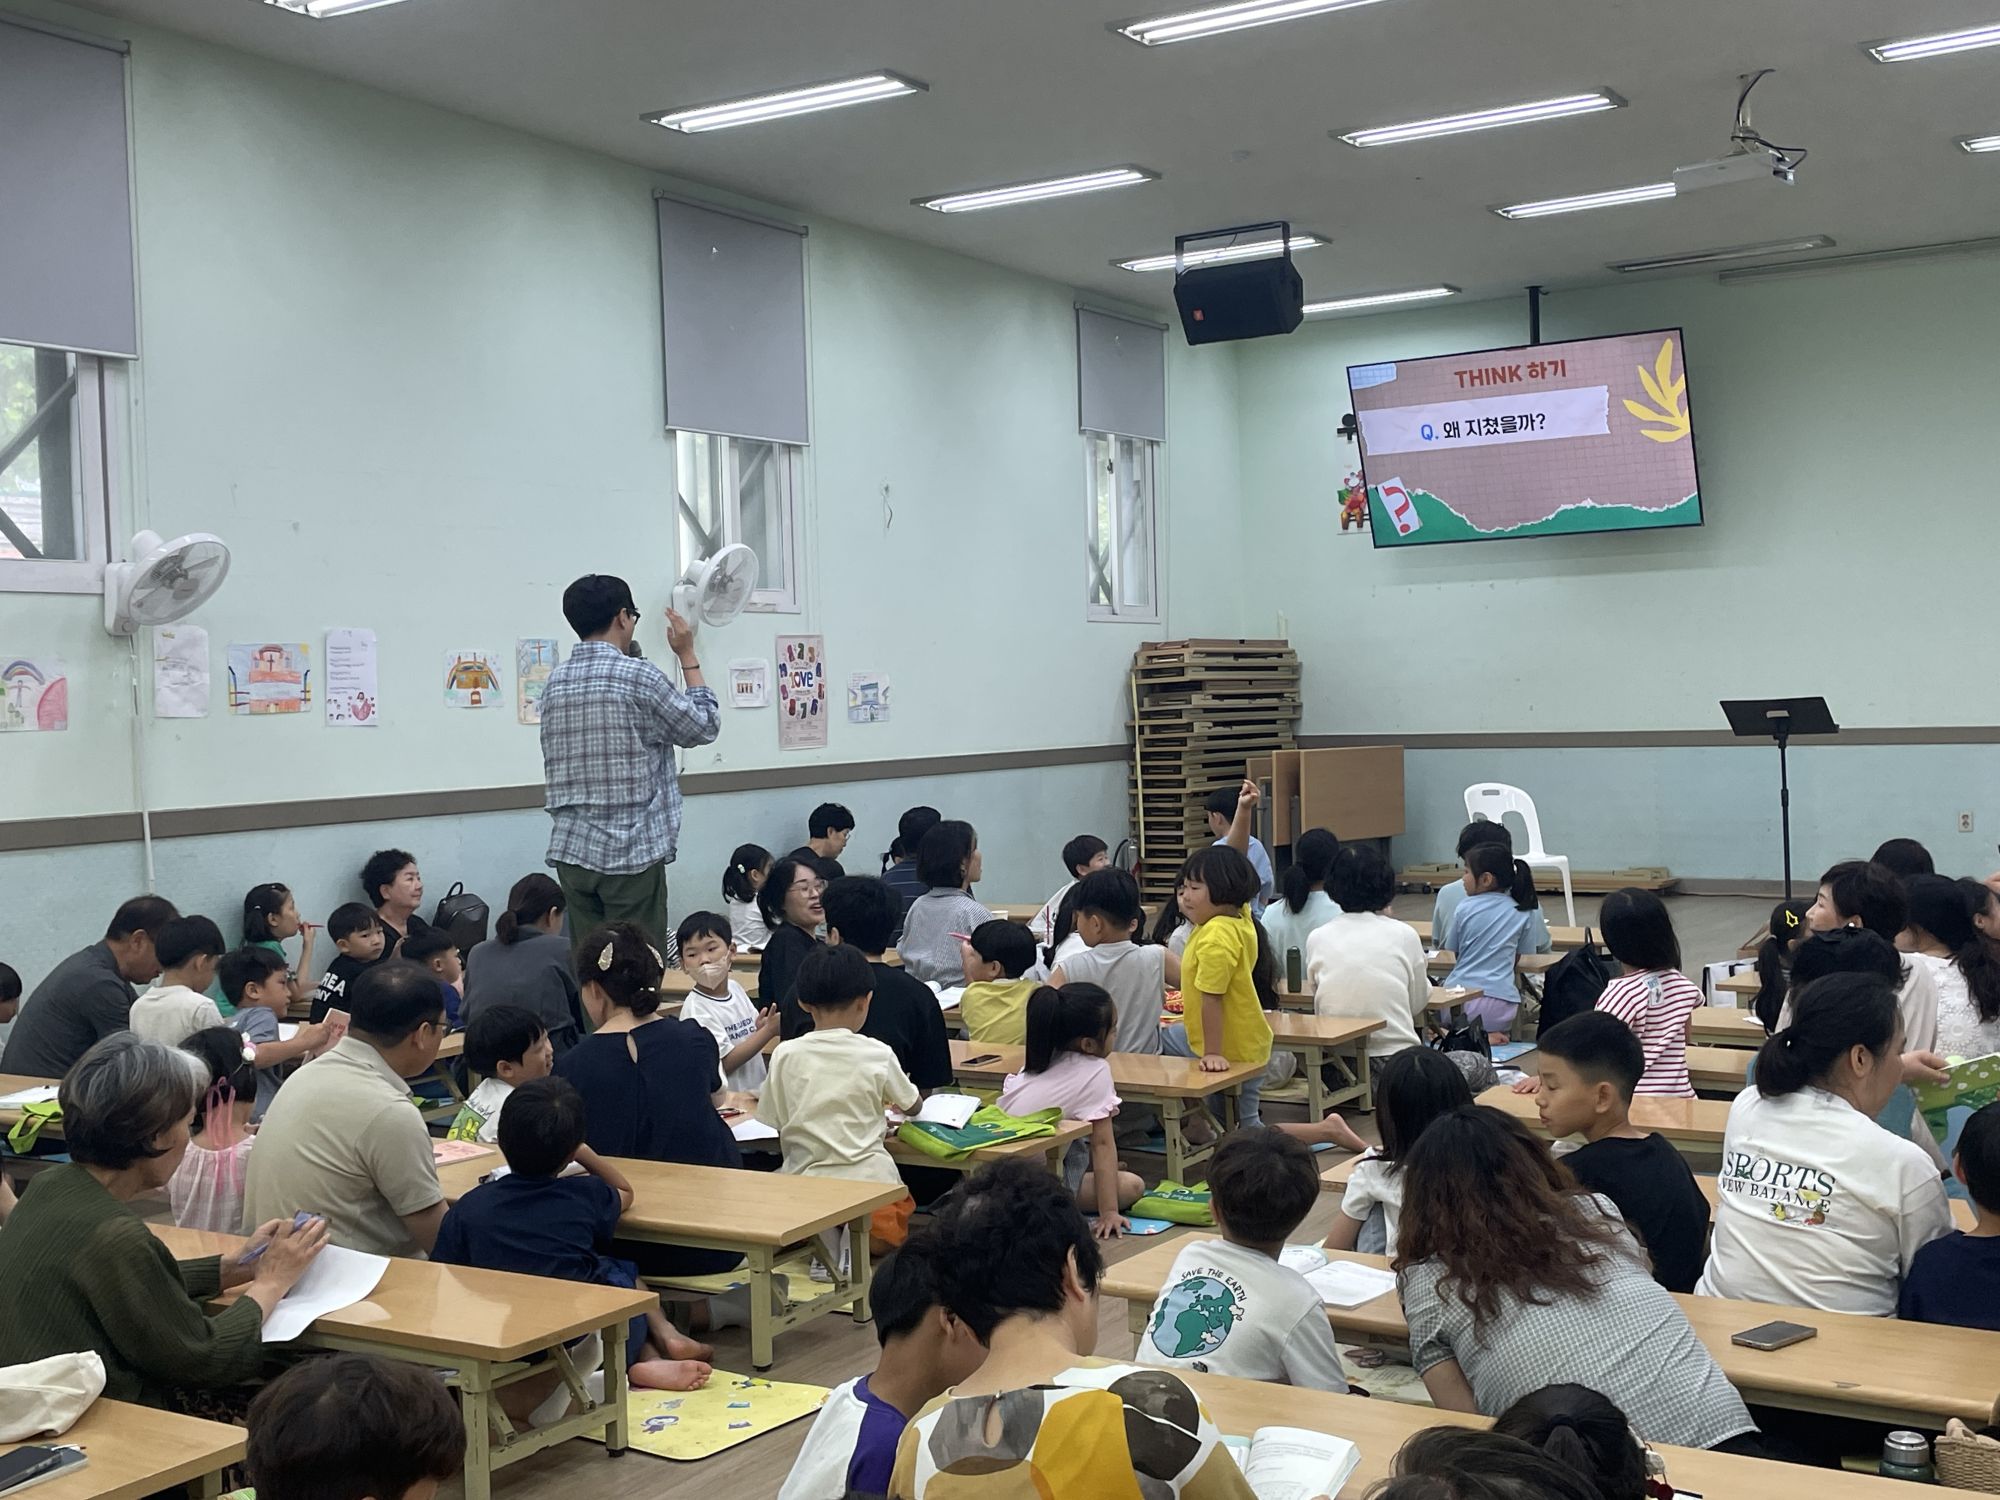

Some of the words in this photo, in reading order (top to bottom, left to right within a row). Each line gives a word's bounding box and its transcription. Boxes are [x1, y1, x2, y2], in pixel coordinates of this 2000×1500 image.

[1454, 365, 1522, 388] THINK
[1527, 359, 1567, 380] 하기
[1420, 424, 1439, 441] Q.
[1443, 421, 1460, 439] 왜
[1467, 413, 1546, 438] 지쳤을까?
[1724, 1151, 1836, 1197] SPORTS
[1181, 1267, 1204, 1281] SAVE
[1208, 1268, 1223, 1279] THE
[1225, 1276, 1248, 1303] EARTH
